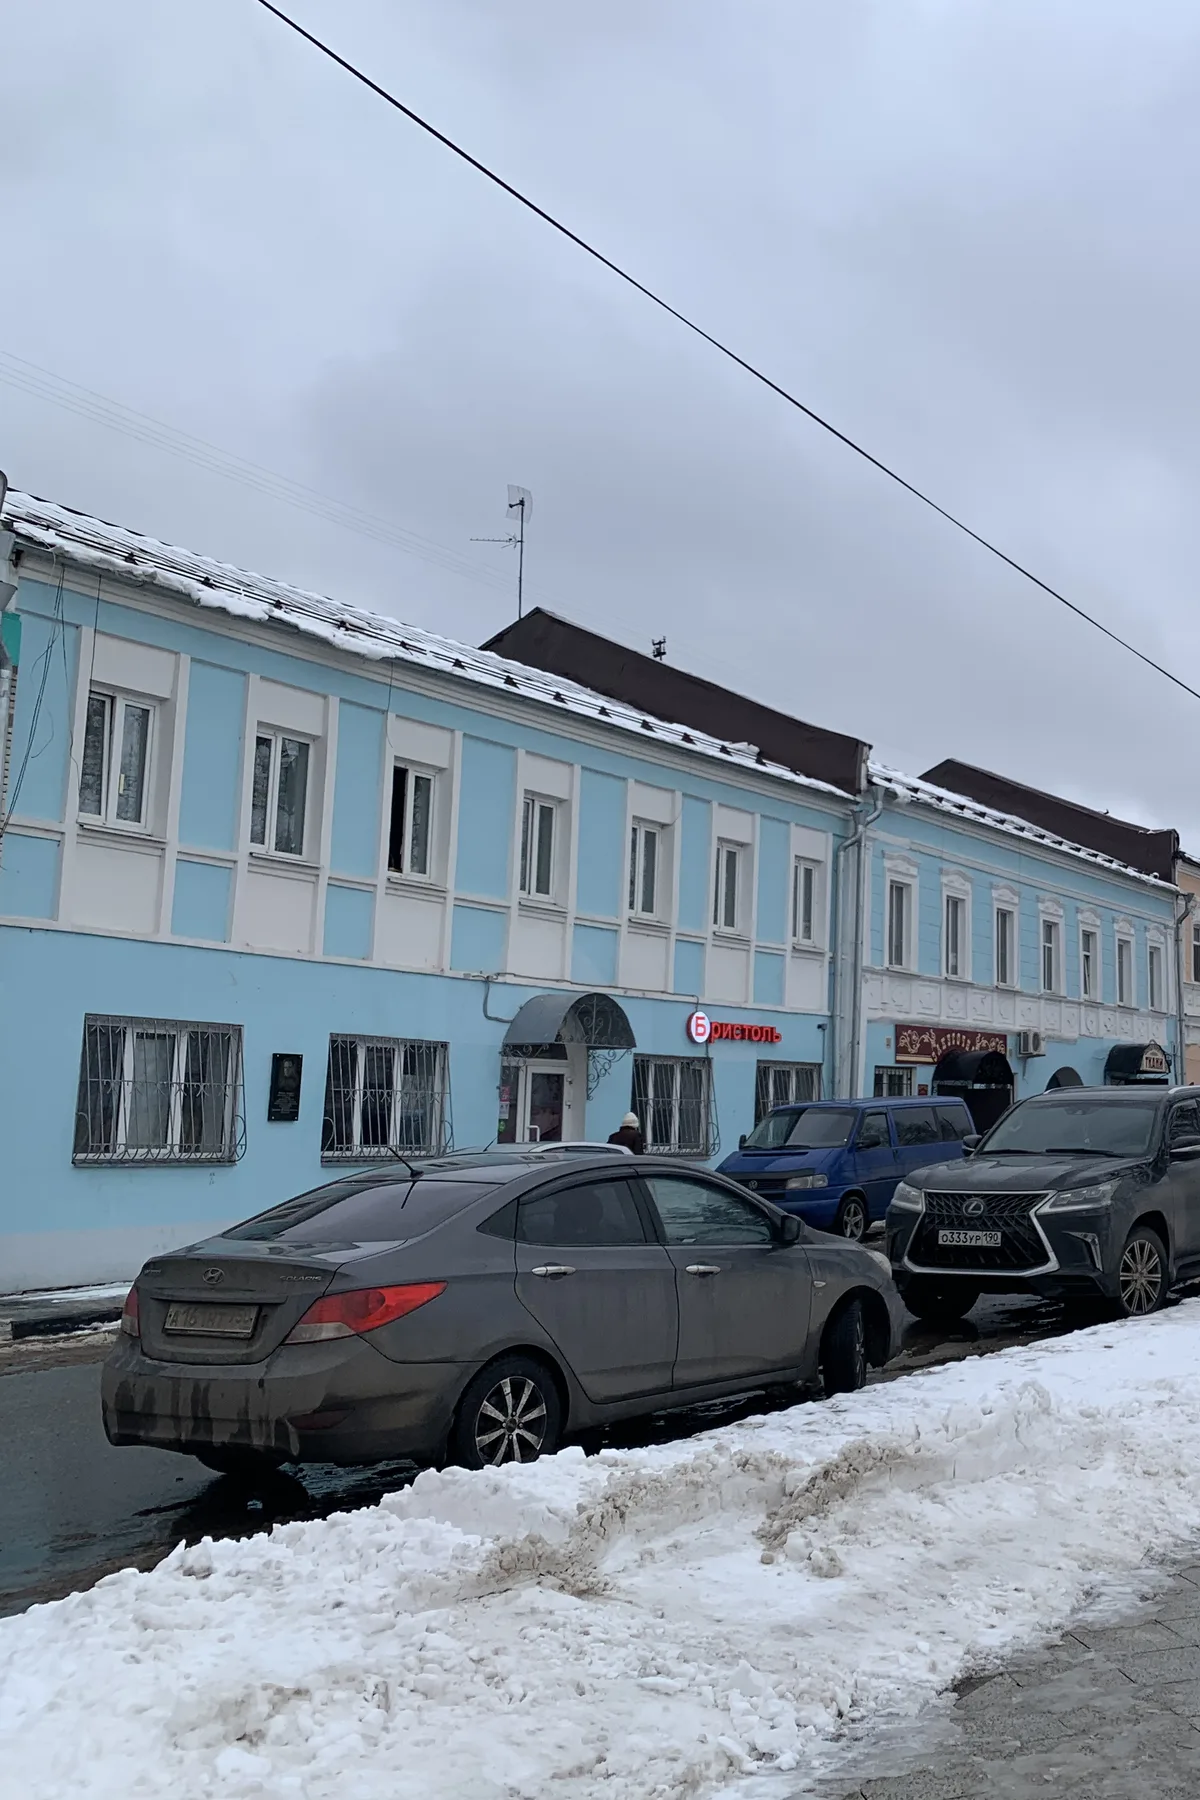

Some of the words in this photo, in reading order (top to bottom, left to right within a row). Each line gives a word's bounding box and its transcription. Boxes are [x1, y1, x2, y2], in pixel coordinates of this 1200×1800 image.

[695, 1016, 782, 1044] Бристоль
[941, 1232, 981, 1244] О333УР
[983, 1233, 998, 1242] 190
